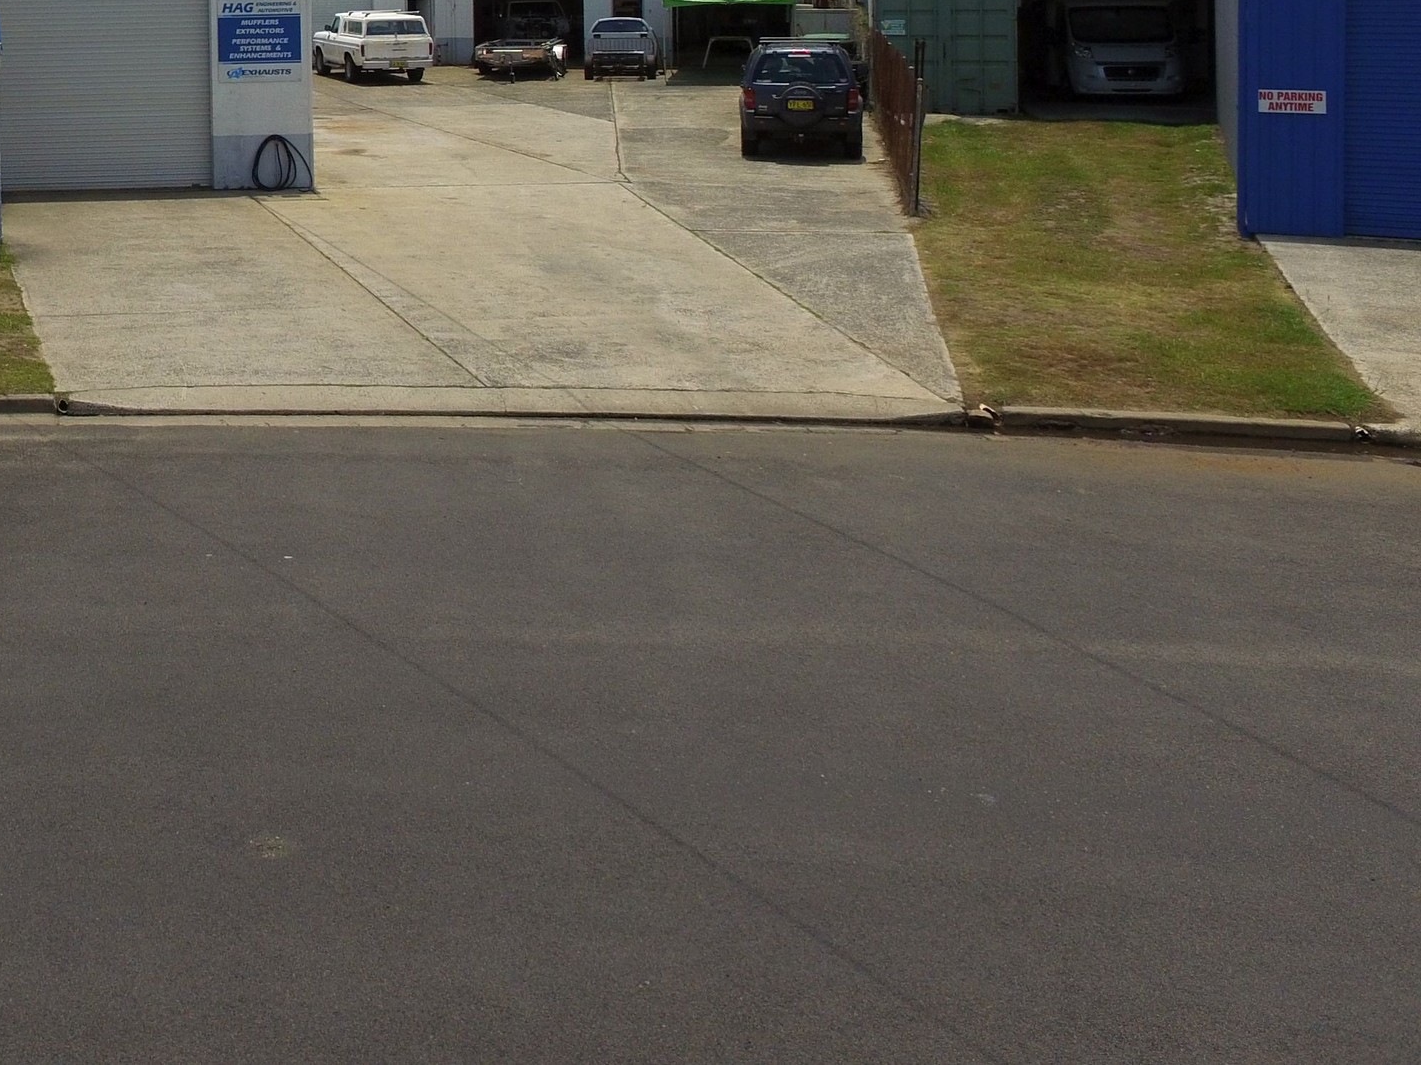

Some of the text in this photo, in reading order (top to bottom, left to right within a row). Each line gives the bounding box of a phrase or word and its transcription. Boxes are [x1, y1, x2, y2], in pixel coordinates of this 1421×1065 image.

[222, 2, 254, 13] HAG
[1259, 91, 1323, 102] NO PARKING
[1268, 102, 1314, 112] ANYTIME
